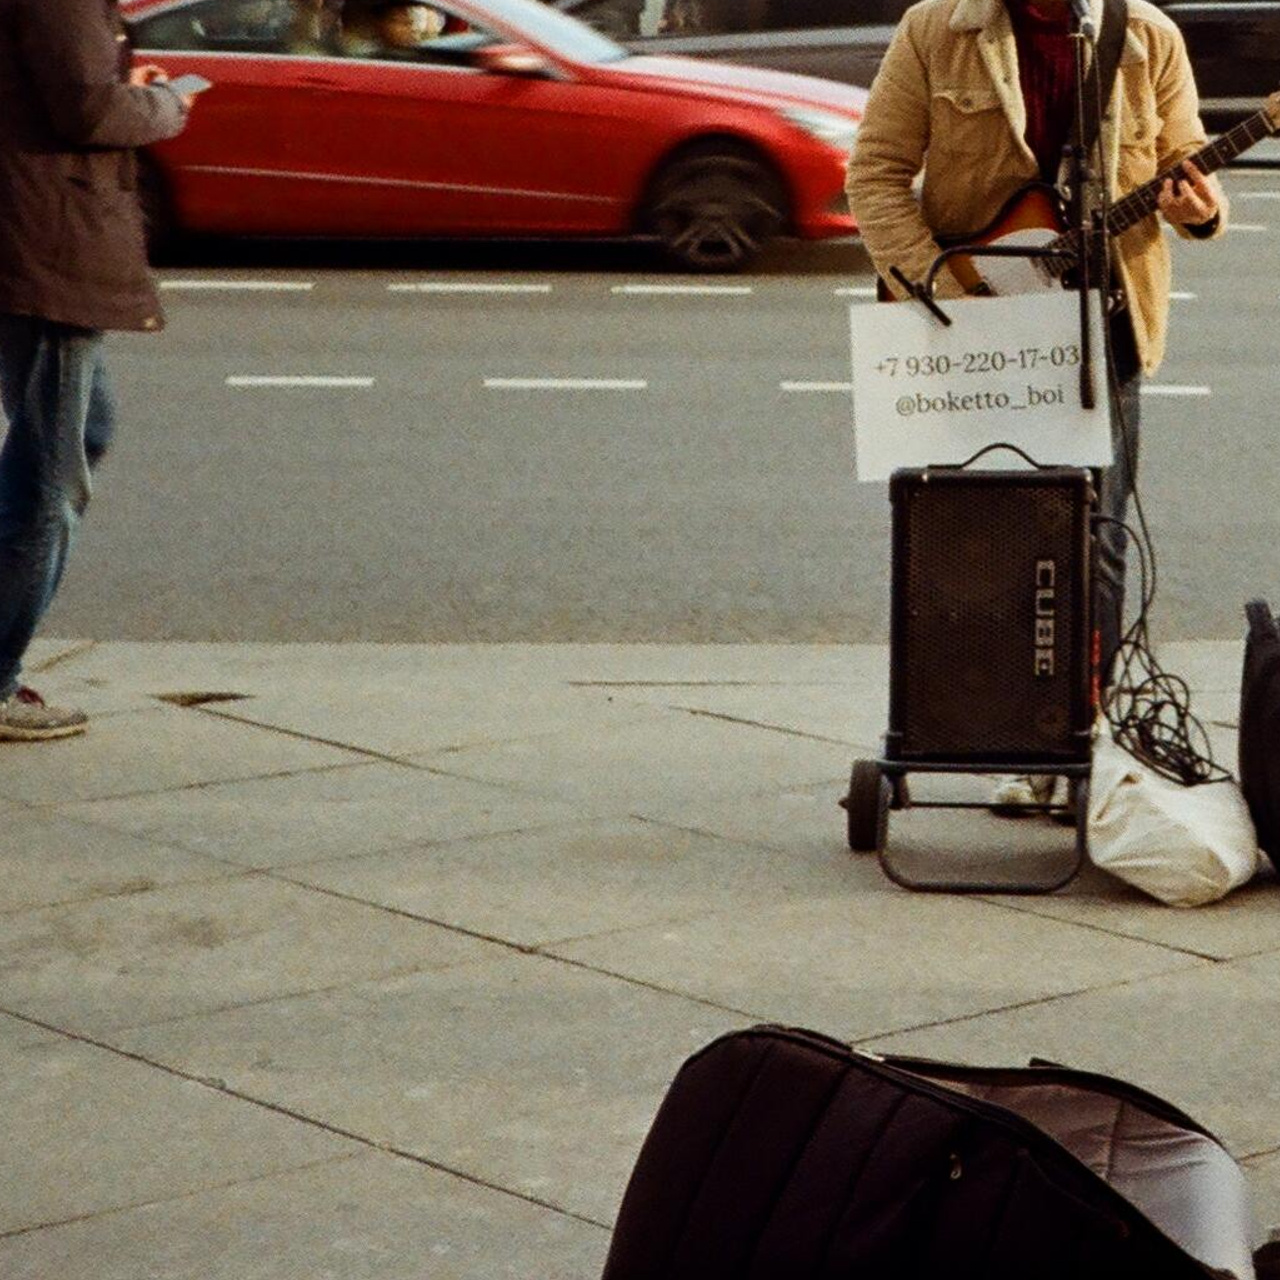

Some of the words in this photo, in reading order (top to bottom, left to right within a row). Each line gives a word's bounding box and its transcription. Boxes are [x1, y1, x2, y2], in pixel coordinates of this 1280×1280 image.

[874, 357, 899, 377] +7
[905, 345, 1080, 377] 930-220-17-03
[895, 384, 1065, 416] @boketto_boi
[1035, 559, 1056, 676] CUBE
